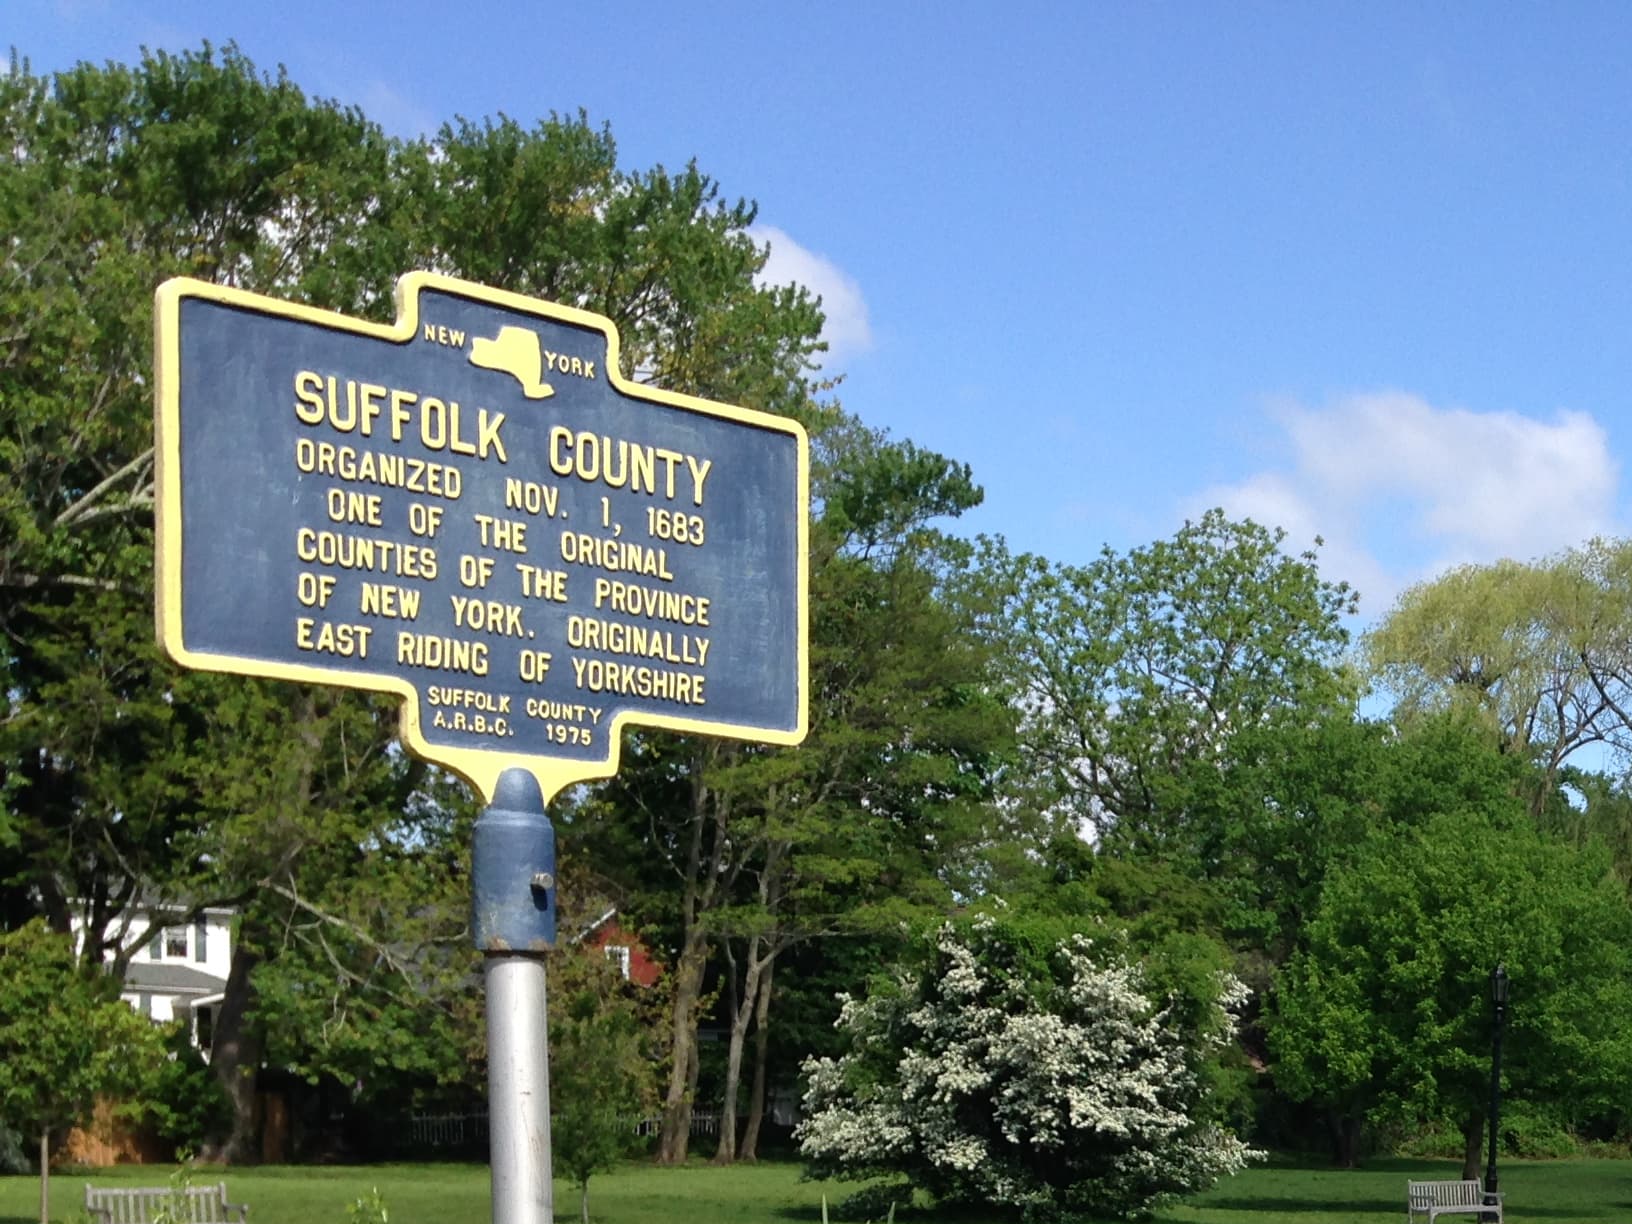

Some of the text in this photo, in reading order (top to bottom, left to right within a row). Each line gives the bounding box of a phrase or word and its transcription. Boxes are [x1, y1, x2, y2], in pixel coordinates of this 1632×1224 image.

[423, 322, 595, 379] NEW YORK
[294, 370, 712, 505] SUFFOLK COUNTY
[295, 437, 705, 545] ORGANIZED NOV. 1, 1683
[327, 487, 674, 580] ONE OF THE ORIGINAL
[296, 526, 711, 626] COUNTIES OF THE PROVINCE
[297, 571, 710, 667] OF NEW YORK. ORIGINALLY
[296, 617, 706, 704] EAST RIDING OF YORKSHIRE
[427, 685, 602, 725] SUFFOLK COUNTY
[432, 710, 592, 746] A.R.B.C. 1975
